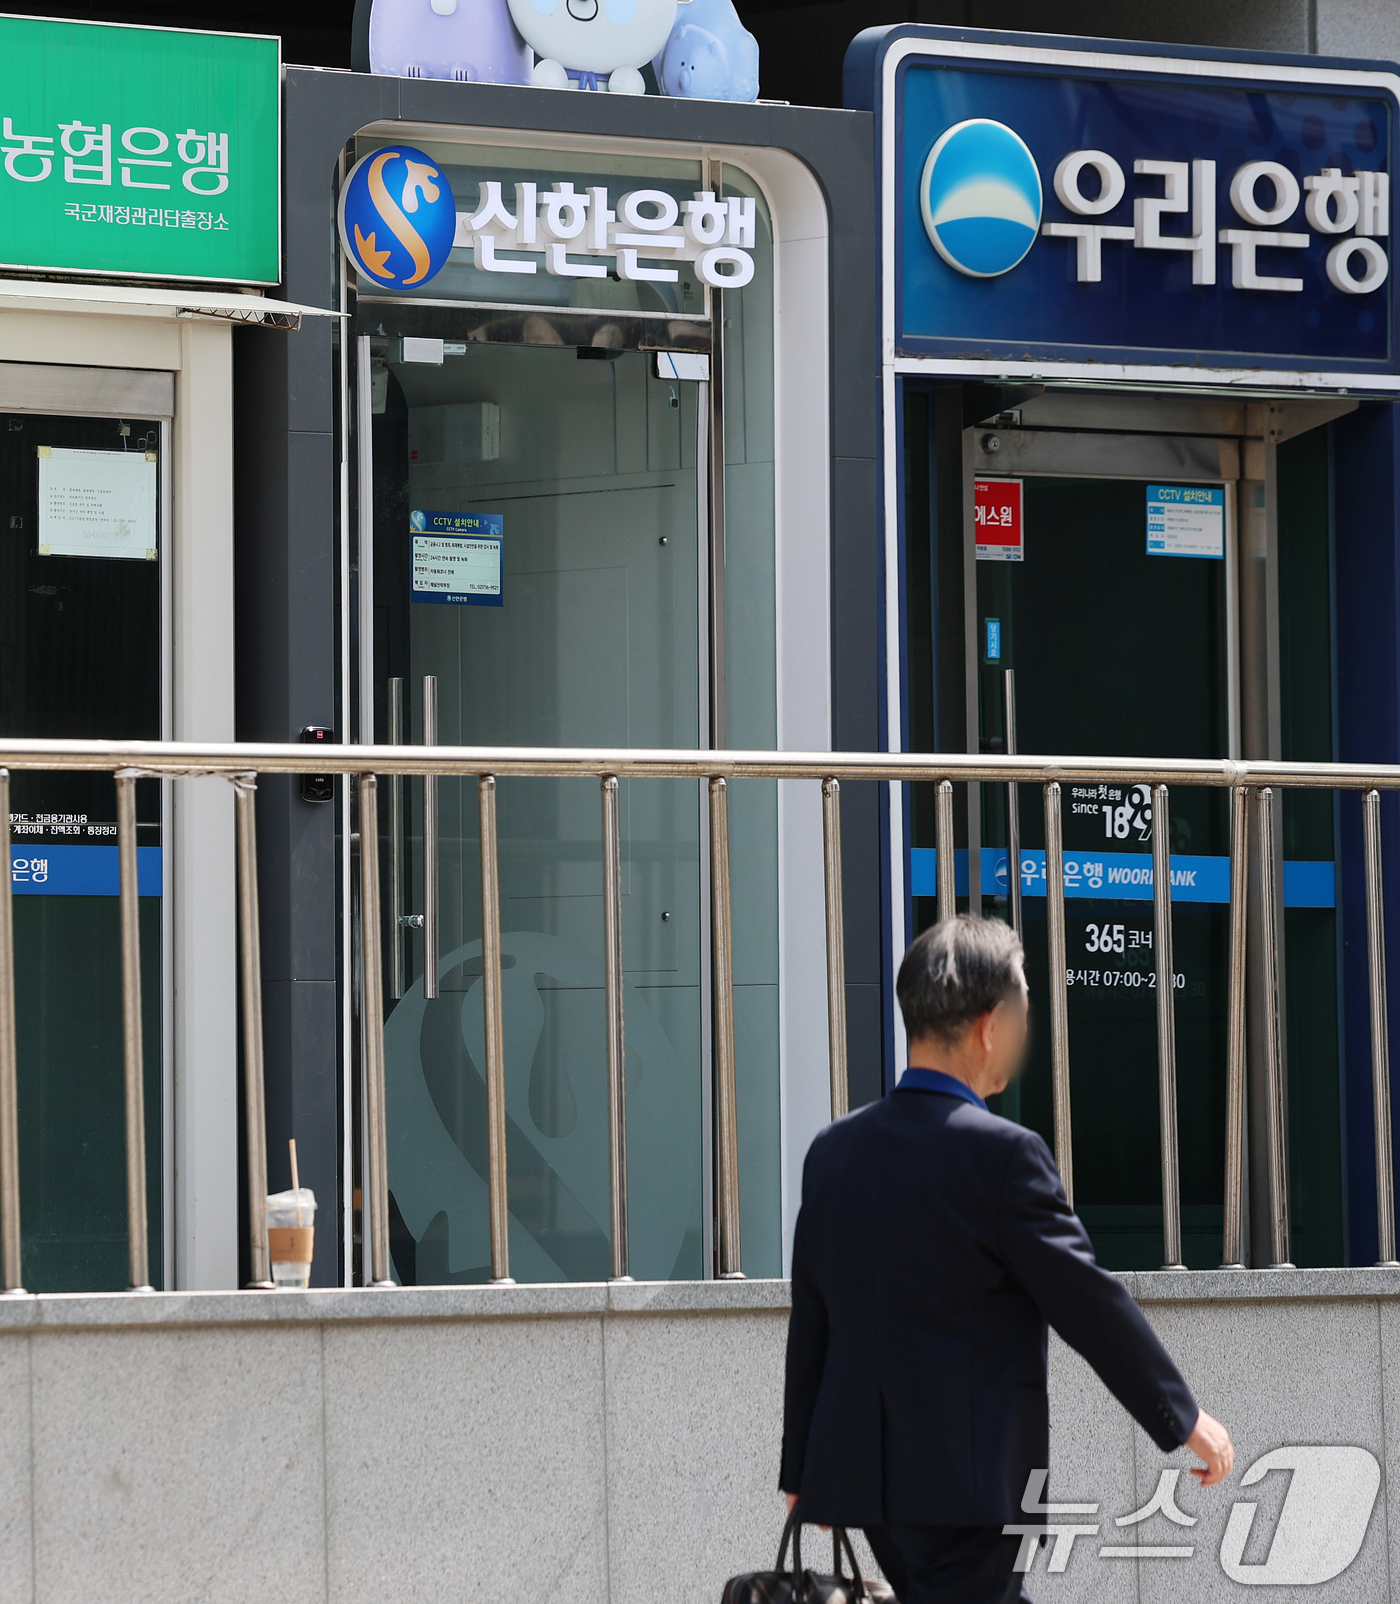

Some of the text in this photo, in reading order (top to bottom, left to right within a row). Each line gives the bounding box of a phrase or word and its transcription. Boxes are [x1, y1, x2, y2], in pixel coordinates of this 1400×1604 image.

[0, 117, 229, 195] 농협은행
[64, 203, 229, 231] 국군재정관리단출장소
[1042, 150, 1389, 293] 우리은행
[463, 181, 756, 288] 신한은행
[1158, 489, 1213, 502] CCTV 설치안내
[433, 517, 480, 528] CCTV 설치안내
[974, 505, 1012, 526] 에스원
[1071, 784, 1122, 801] 우리나라 첫 은행
[1021, 860, 1103, 888] 우은행
[1085, 923, 1152, 953] 365 코너
